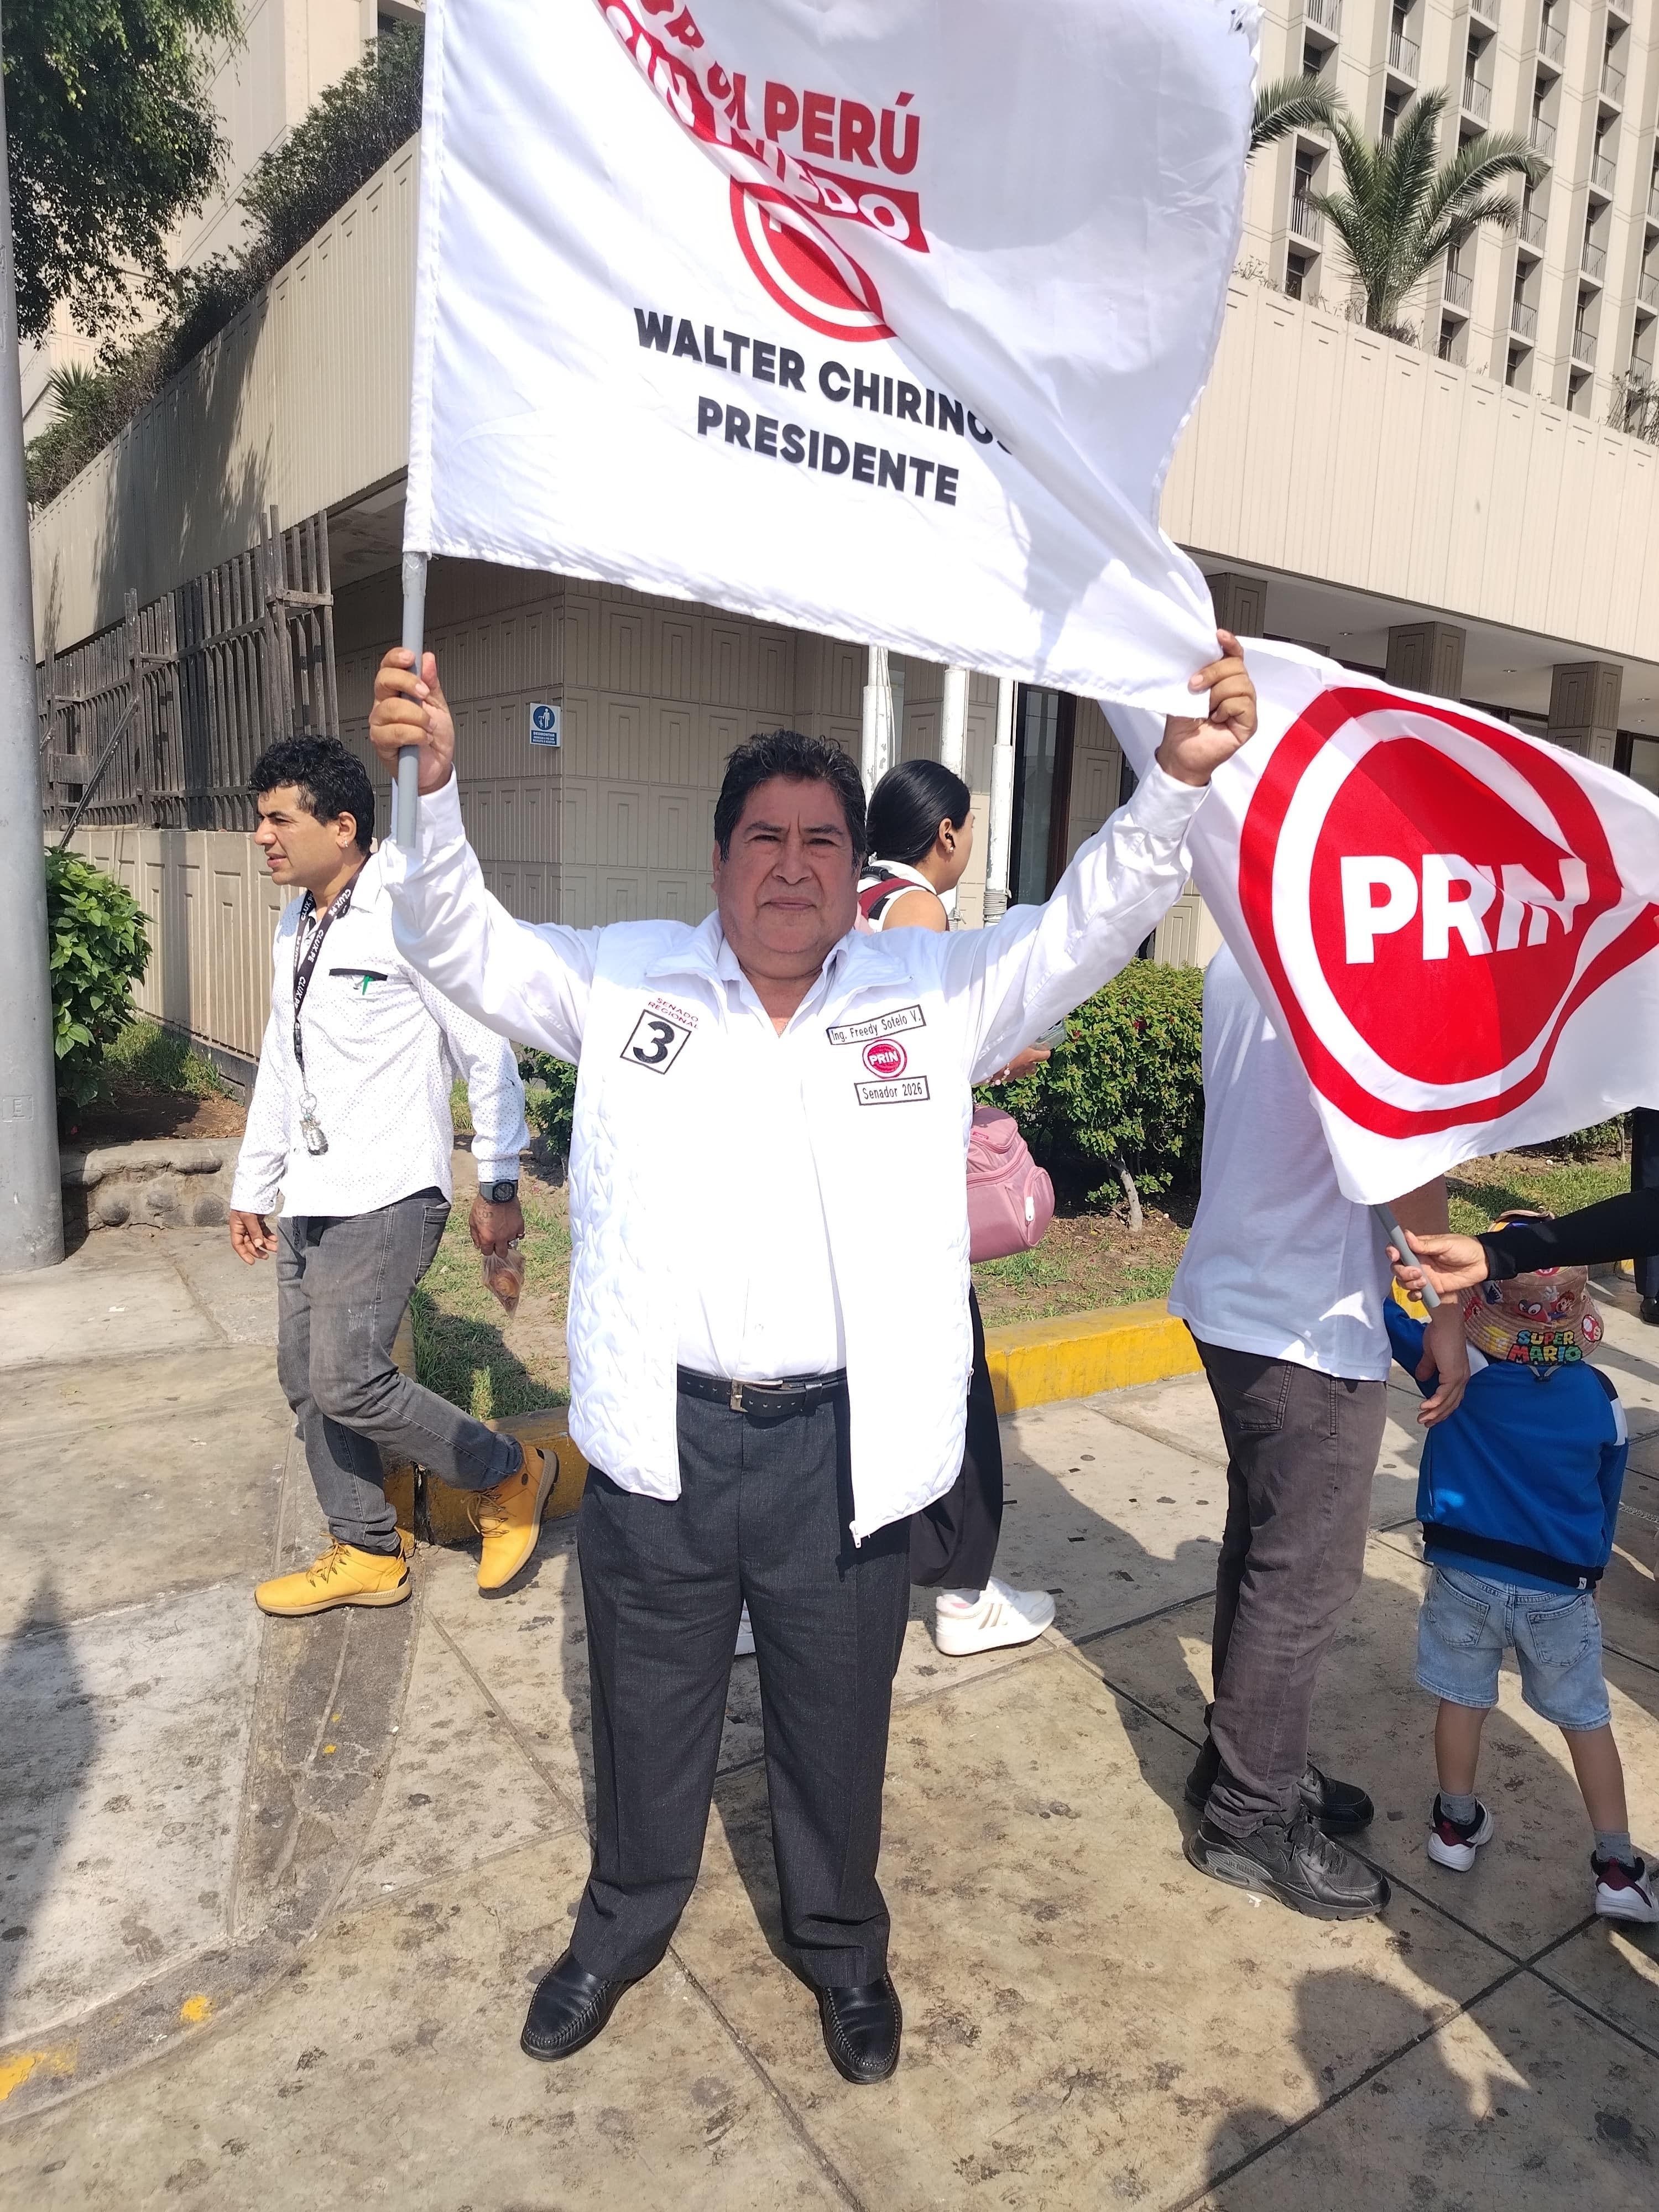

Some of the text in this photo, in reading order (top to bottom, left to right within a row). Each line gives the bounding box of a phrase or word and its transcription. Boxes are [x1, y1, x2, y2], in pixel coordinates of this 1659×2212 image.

[764, 91, 920, 175] PERÚ
[634, 307, 1013, 455] WALTER CHIRINO
[697, 395, 959, 507] PRESIDENTE
[1340, 854, 1591, 964] PRIN
[307, 930, 324, 963] CLUX.PE
[648, 1001, 699, 1029] REGIONAL
[656, 998, 698, 1022] SENADO
[831, 1010, 921, 1042] Ing. Freedy Sotelo V.
[633, 1021, 675, 1064] 3
[869, 1051, 899, 1066] PRIN
[862, 1082, 922, 1100] Senador 2026
[1506, 1344, 1583, 1363] MARIO
[1516, 1330, 1575, 1345] SUPER
